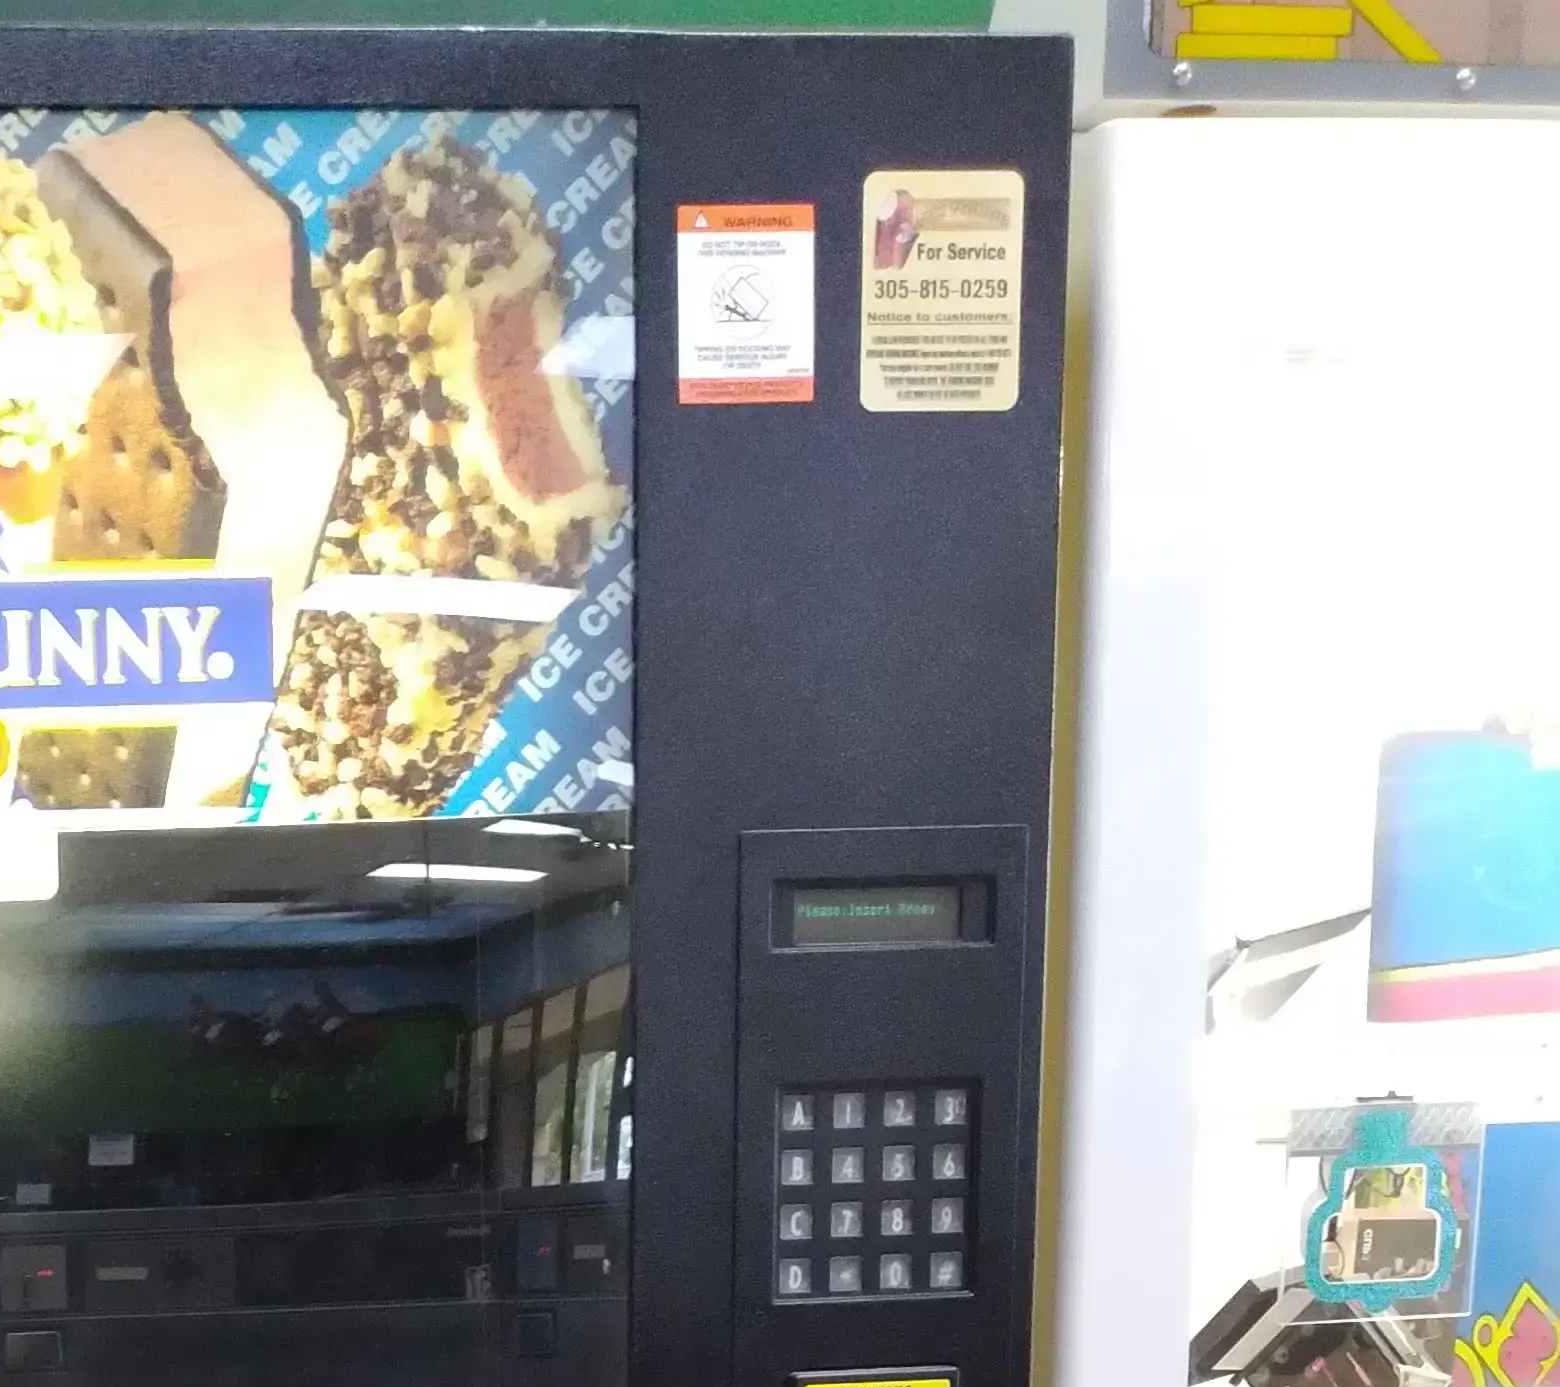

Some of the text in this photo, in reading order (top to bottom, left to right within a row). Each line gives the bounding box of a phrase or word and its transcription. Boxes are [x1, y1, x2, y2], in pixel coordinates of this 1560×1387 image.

[917, 242, 1006, 261] For Service
[874, 278, 1008, 300] 305-815-0259
[517, 632, 584, 703] ICE
[572, 647, 635, 716] ICE
[792, 1101, 805, 1126] A
[893, 1153, 904, 1179] 5
[943, 1152, 956, 1178] 6
[891, 1207, 904, 1233] 8
[788, 1264, 802, 1292] D
